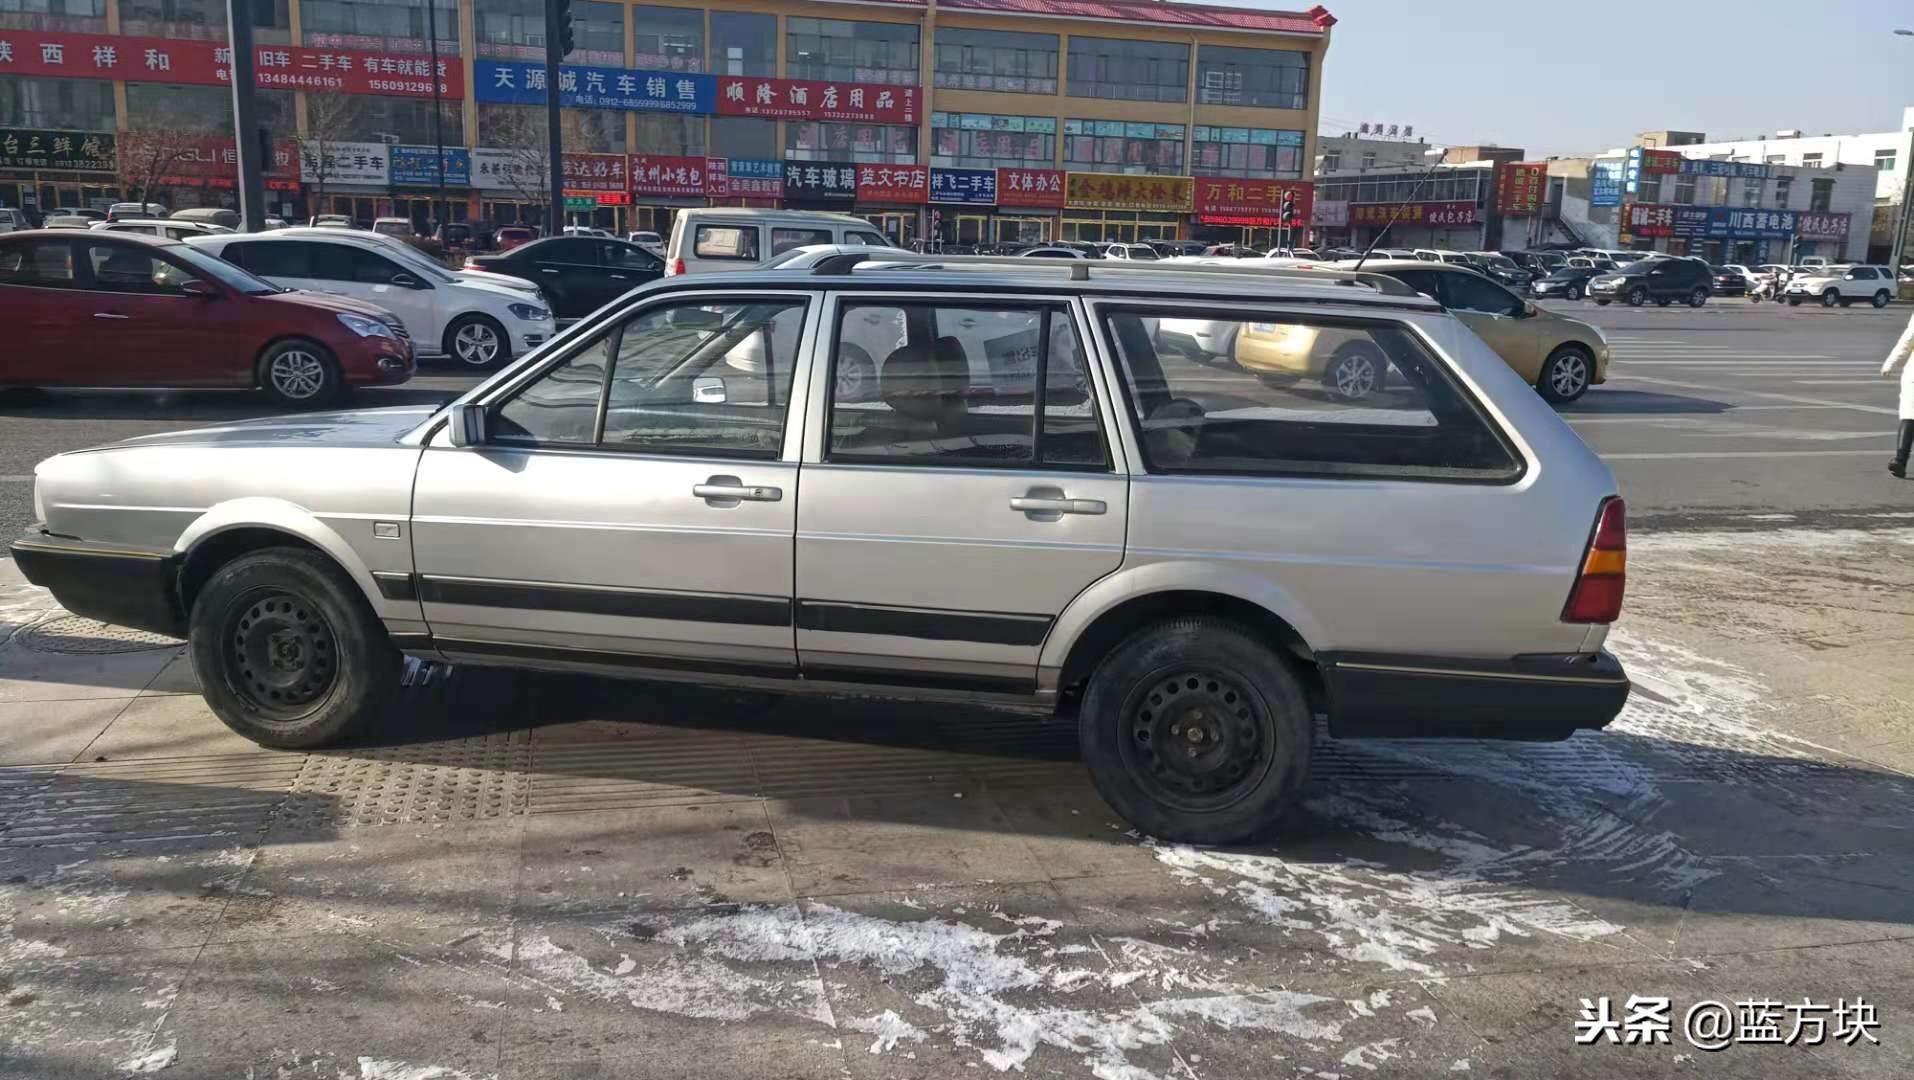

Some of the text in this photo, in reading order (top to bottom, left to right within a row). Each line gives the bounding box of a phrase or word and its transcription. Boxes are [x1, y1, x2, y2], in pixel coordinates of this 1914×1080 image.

[258, 51, 291, 68] 旧车
[301, 54, 352, 71] 二手车
[368, 80, 447, 93] 1560912968
[633, 163, 703, 187] 杭州小笼包
[786, 165, 856, 190] 汽车玻璃
[931, 172, 995, 192] 祥飞二手车
[1008, 172, 1061, 192] 文体办公
[1728, 211, 1794, 231] 川西蓄电池
